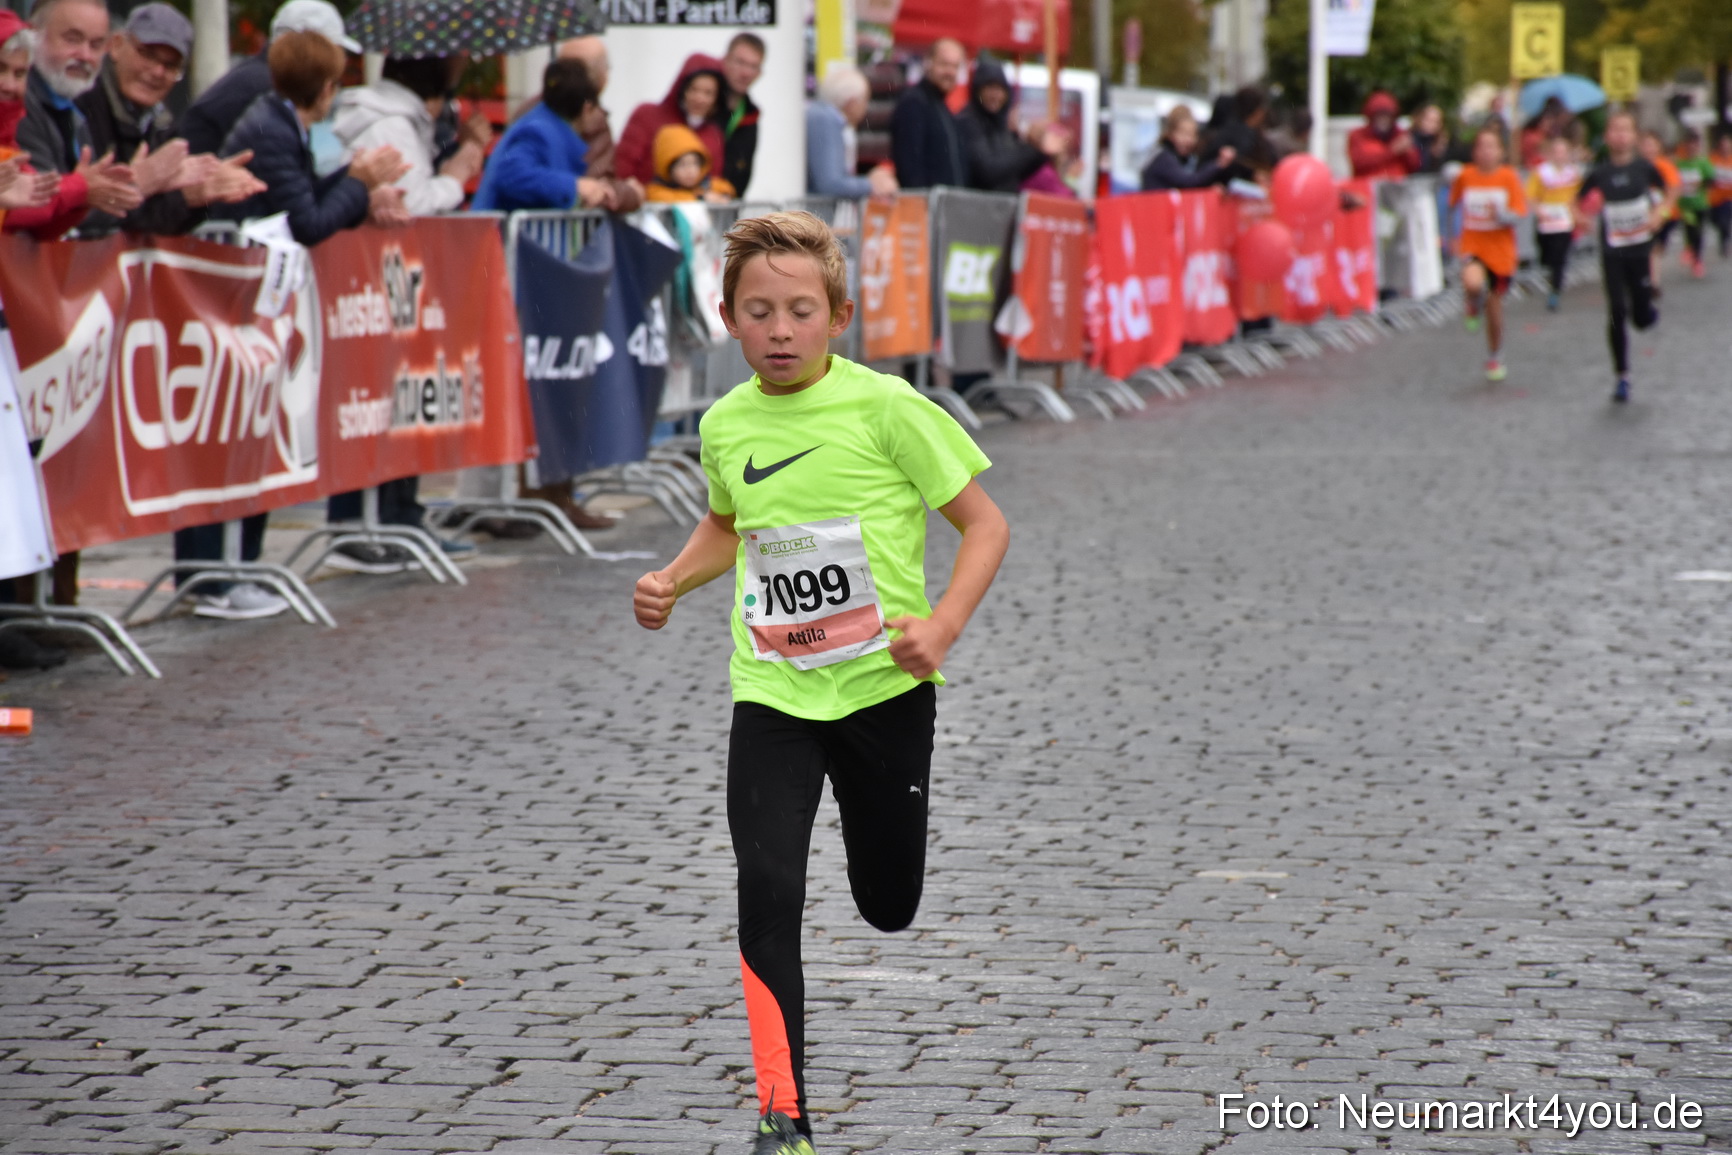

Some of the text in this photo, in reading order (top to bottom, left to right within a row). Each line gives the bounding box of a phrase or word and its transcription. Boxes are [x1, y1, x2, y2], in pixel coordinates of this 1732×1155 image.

[1525, 27, 1551, 60] C
[769, 535, 817, 554] BOCK
[758, 563, 851, 617] 7099
[787, 627, 827, 646] Attila
